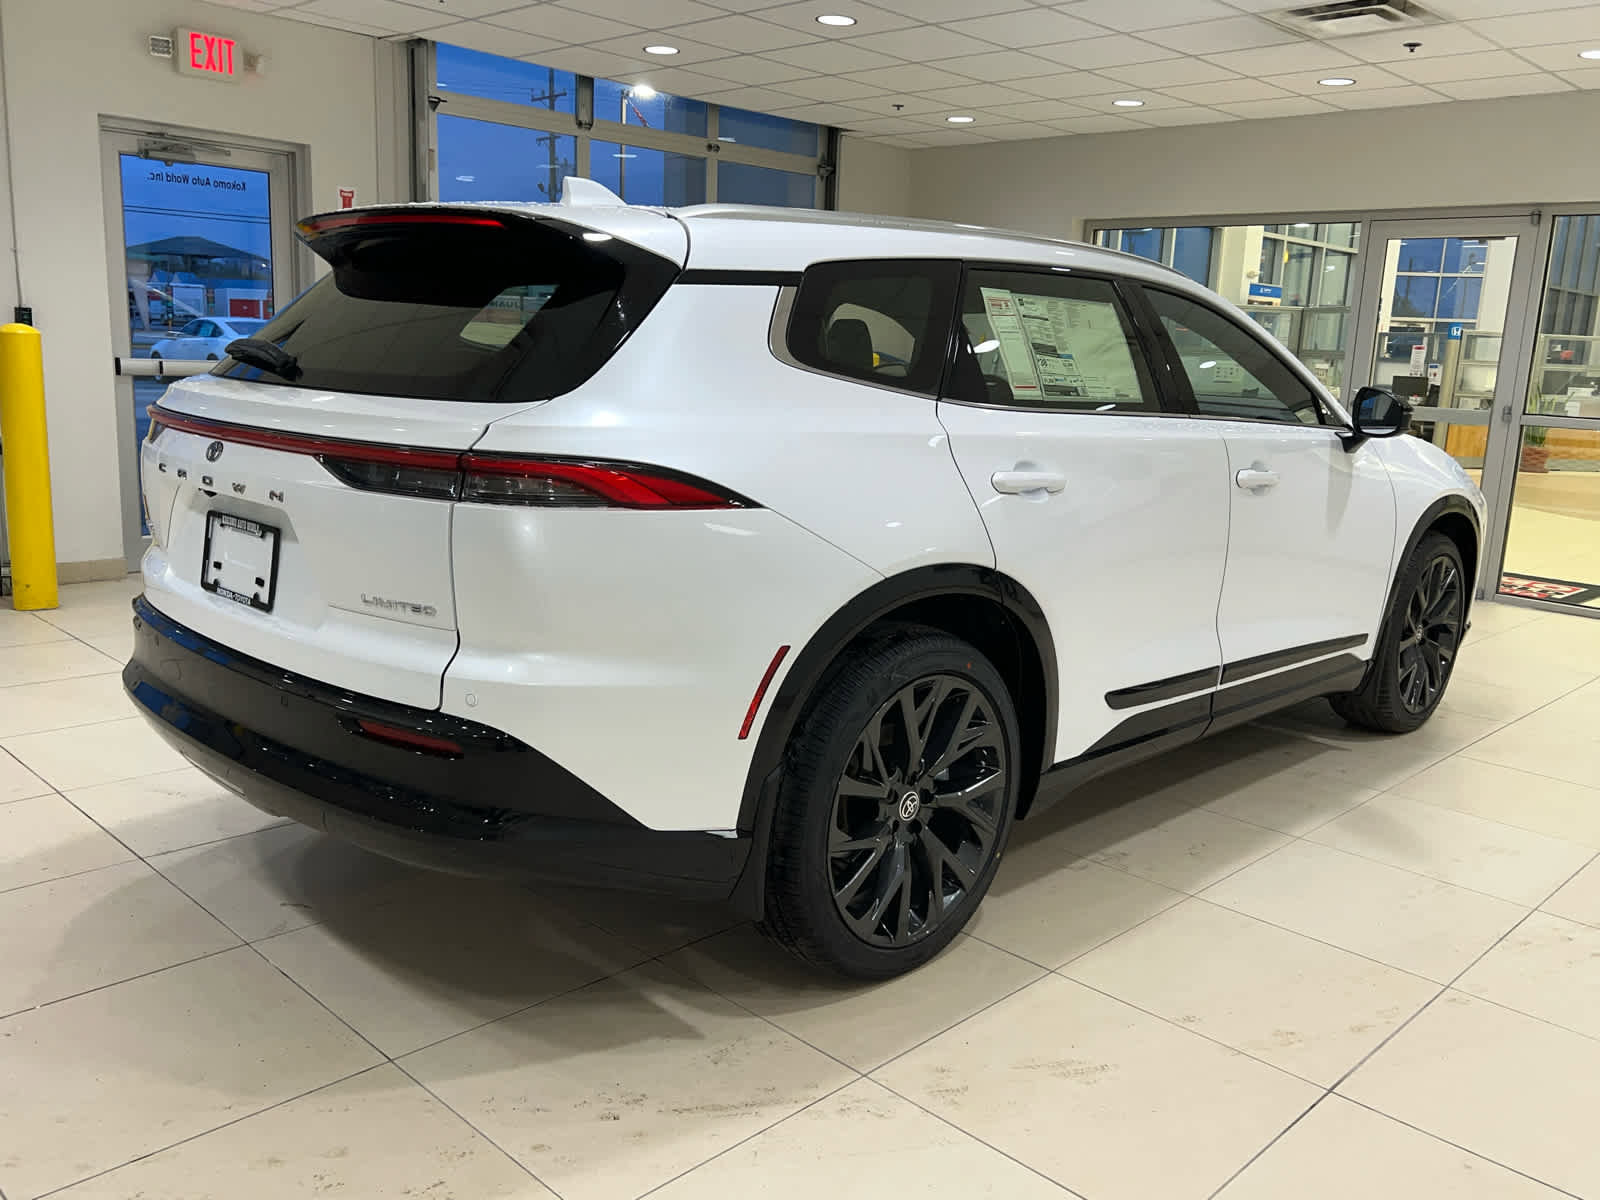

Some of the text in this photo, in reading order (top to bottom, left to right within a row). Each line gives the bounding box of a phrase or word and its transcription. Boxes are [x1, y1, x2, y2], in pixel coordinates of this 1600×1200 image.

[190, 32, 235, 75] EXIT
[158, 463, 284, 502] CROWN
[360, 593, 437, 616] LIMITED
